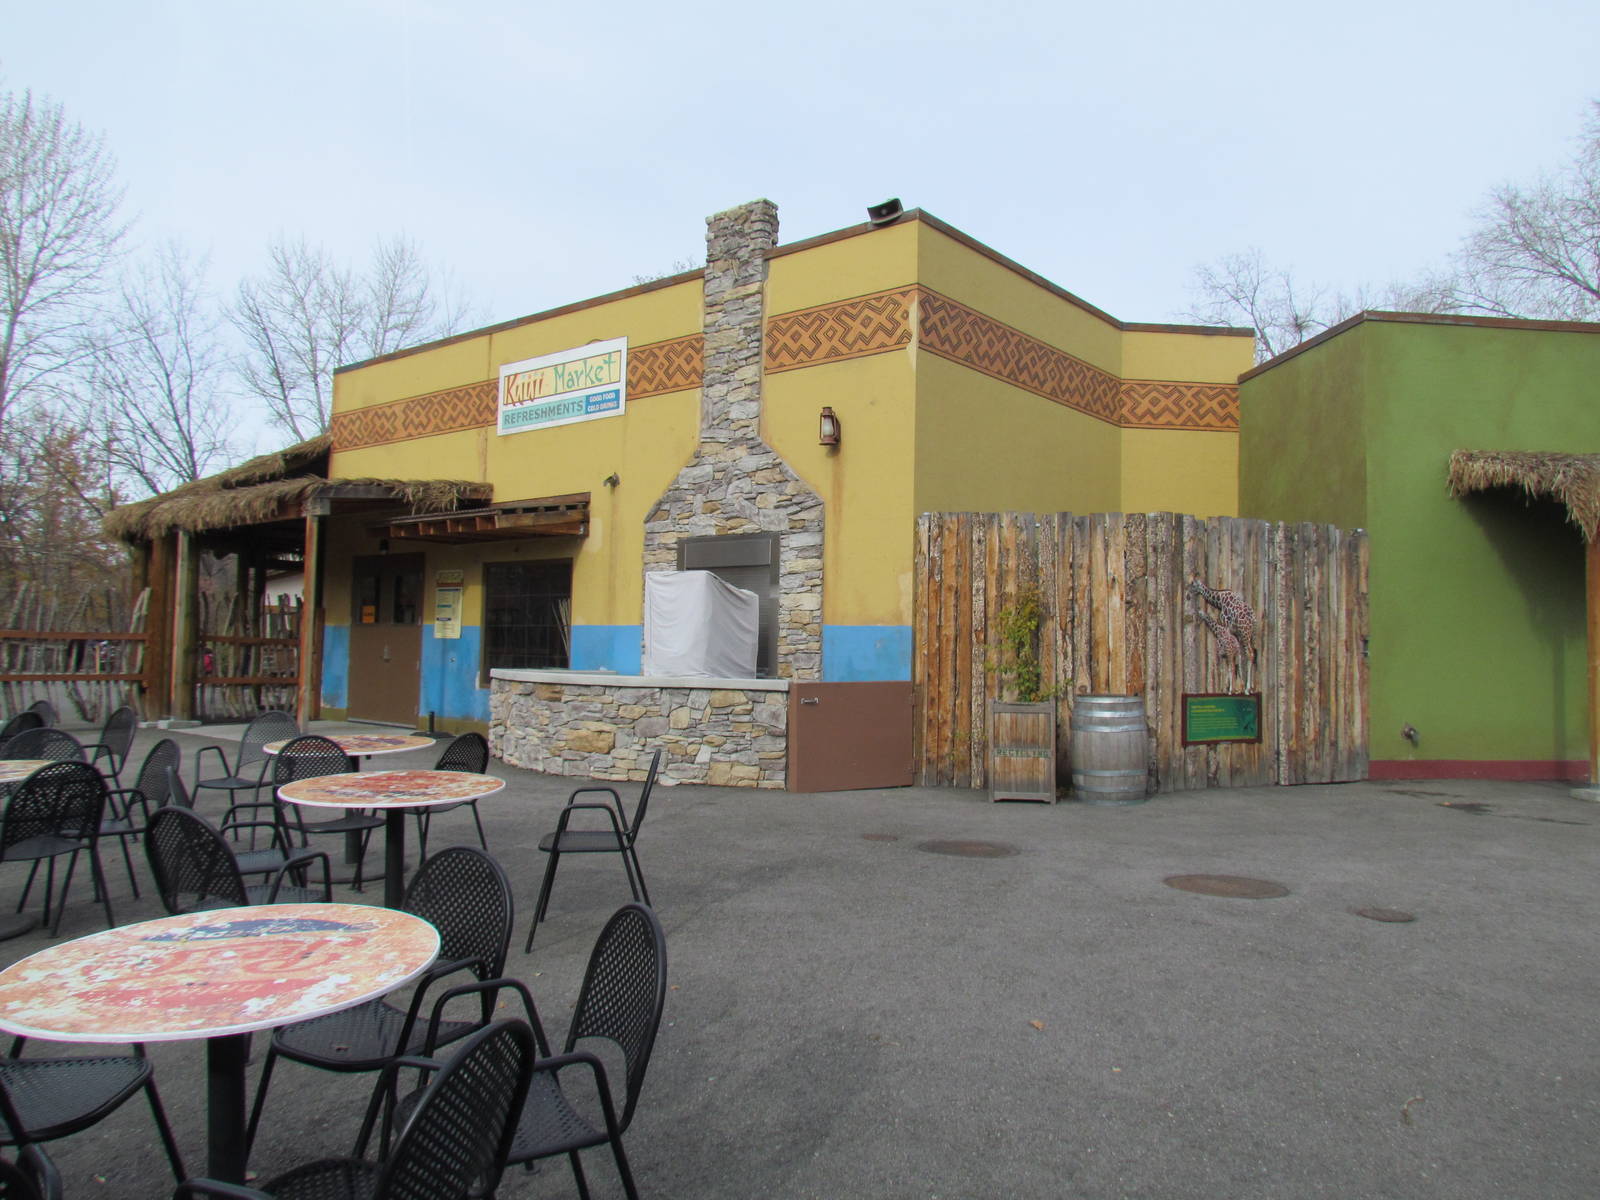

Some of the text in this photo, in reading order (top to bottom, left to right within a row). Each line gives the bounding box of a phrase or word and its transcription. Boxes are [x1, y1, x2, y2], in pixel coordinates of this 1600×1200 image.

[553, 352, 616, 393] Market
[590, 392, 615, 403] GOOD FOOD
[503, 400, 584, 425] REFRESHMENTS
